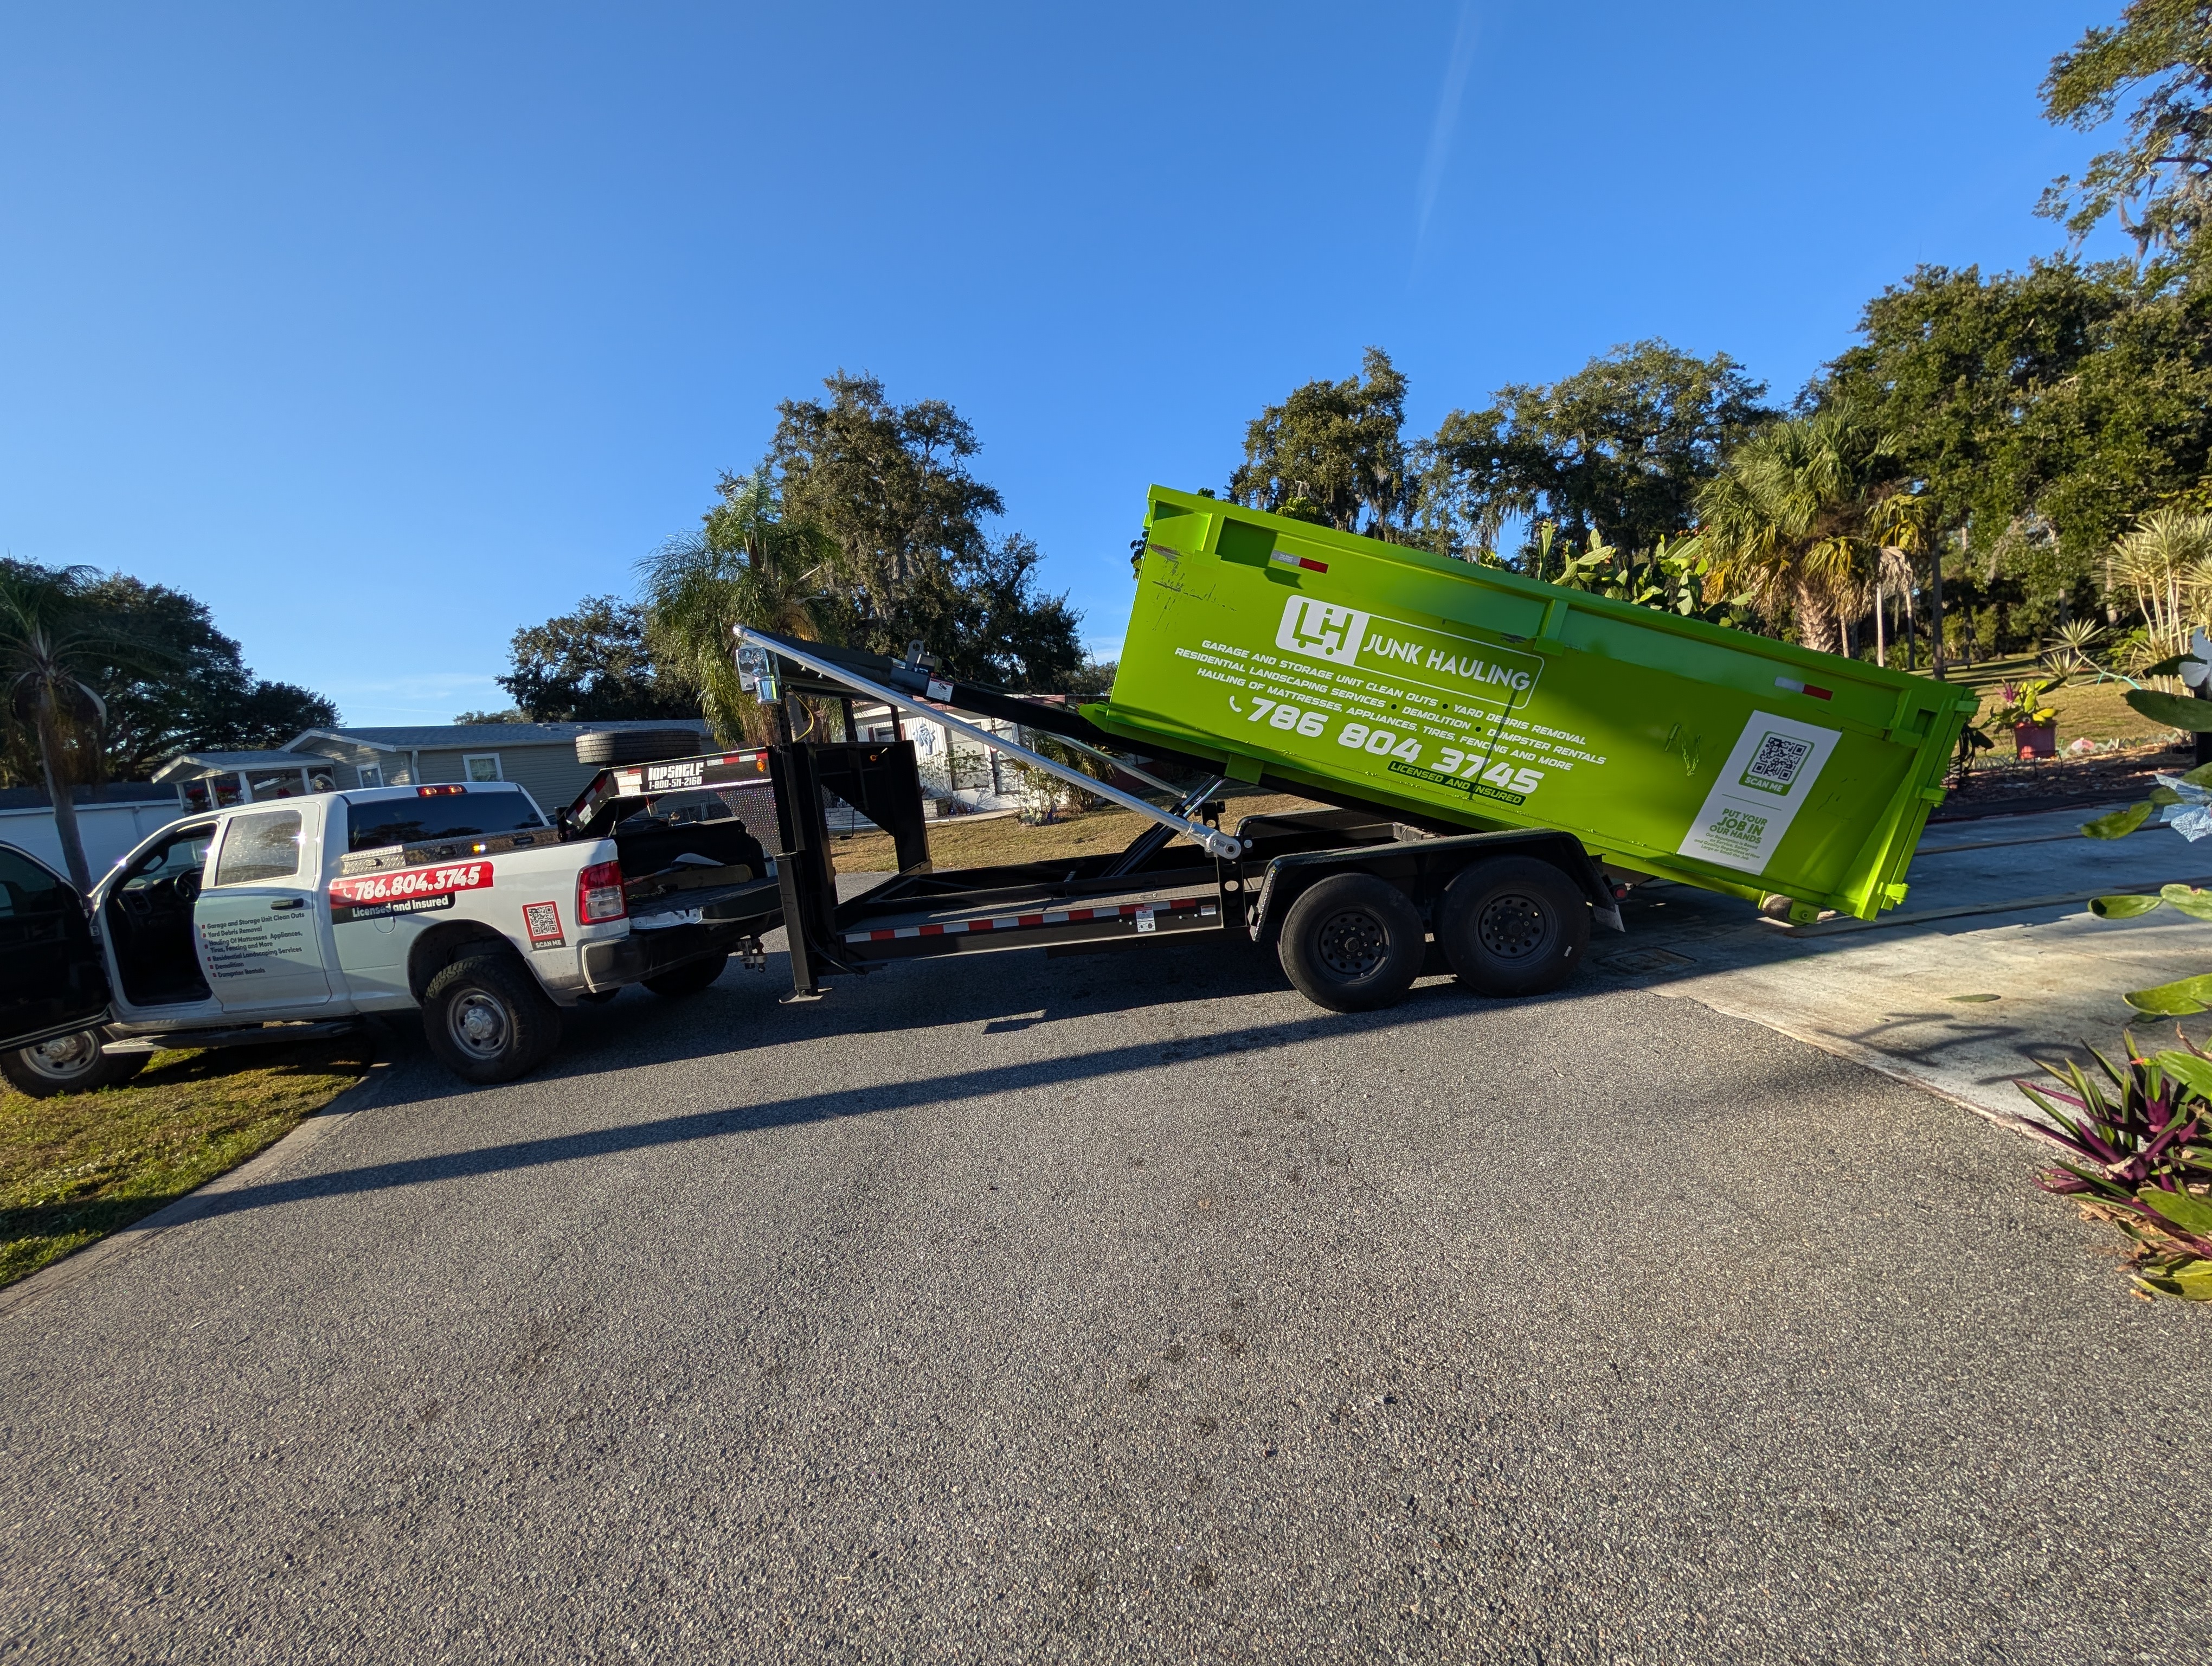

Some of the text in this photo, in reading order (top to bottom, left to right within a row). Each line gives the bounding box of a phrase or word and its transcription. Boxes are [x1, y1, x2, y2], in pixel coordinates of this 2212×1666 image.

[1363, 634, 1531, 691] JUNK HAULING
[1202, 640, 1586, 745] GARAGE AND STORAGE UNIT CLEAN OUTS YARD DEBRIS REMOVAL
[1175, 648, 1606, 765] RESIDENTIAL LANDSCAPING SERVICES DEMOLITION DUMPSTER RENTALS
[1197, 668, 1574, 771] HAULING OF MATTRESSES, APPLIANCES, TIRES, FENCING AND MORE
[1248, 697, 1545, 793] 786 804 3745
[649, 776, 702, 789] 1-800-511-2168
[1391, 762, 1522, 804] LICENSED AND INSURED
[1745, 777, 1783, 792] SCAN ME
[1716, 817, 1764, 836] JOB IN
[1722, 808, 1768, 826] PUT YOUR
[1709, 825, 1762, 844] OUR HANDS
[1715, 835, 1739, 844] Reputation
[1703, 841, 1720, 849] Quality
[1721, 844, 1745, 854] Regardless
[355, 866, 481, 901] 786.804.3745
[353, 895, 448, 918] Licensed and Insured
[238, 935, 267, 943] Mattresses
[271, 931, 303, 940] Appliances,
[239, 926, 262, 934] Removal
[213, 952, 242, 962] Residential
[243, 949, 278, 958] Landscaping
